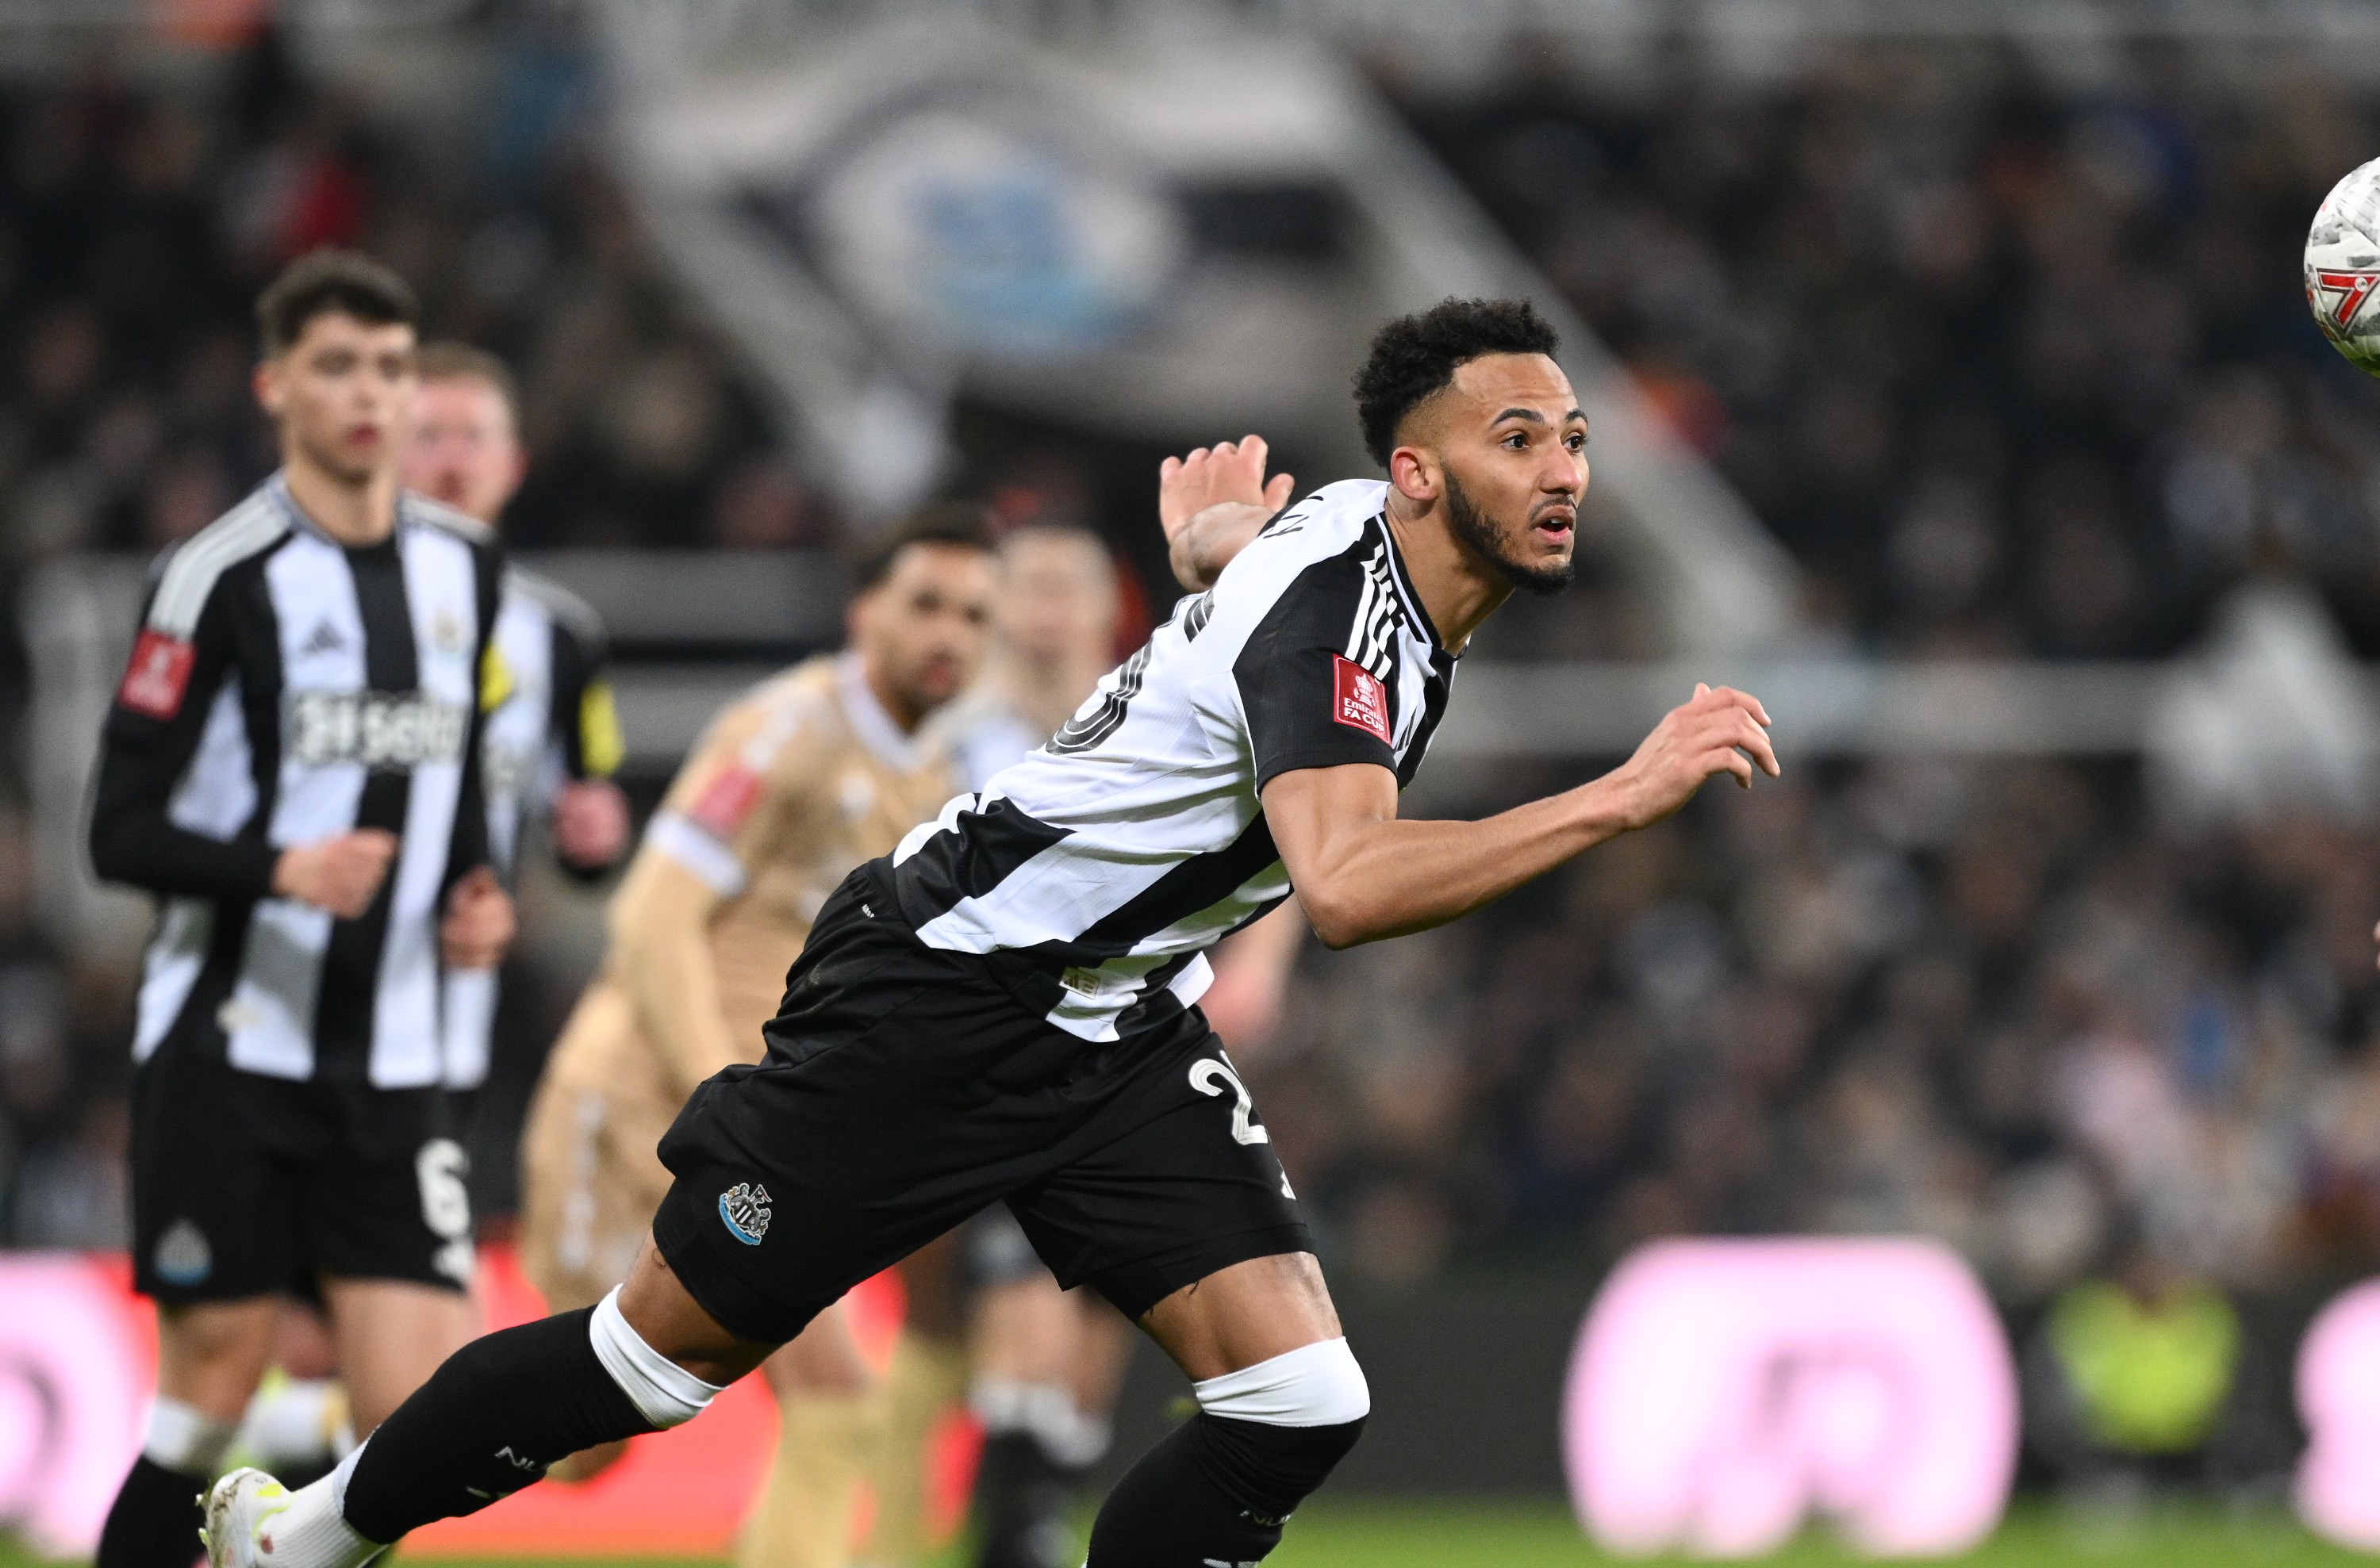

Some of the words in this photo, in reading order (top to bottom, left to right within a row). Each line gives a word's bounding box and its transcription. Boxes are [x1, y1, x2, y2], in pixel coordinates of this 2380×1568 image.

[1344, 707, 1361, 720] FA
[1362, 714, 1385, 732] CUP
[1188, 1049, 1268, 1145] 2
[413, 1138, 472, 1237] 6
